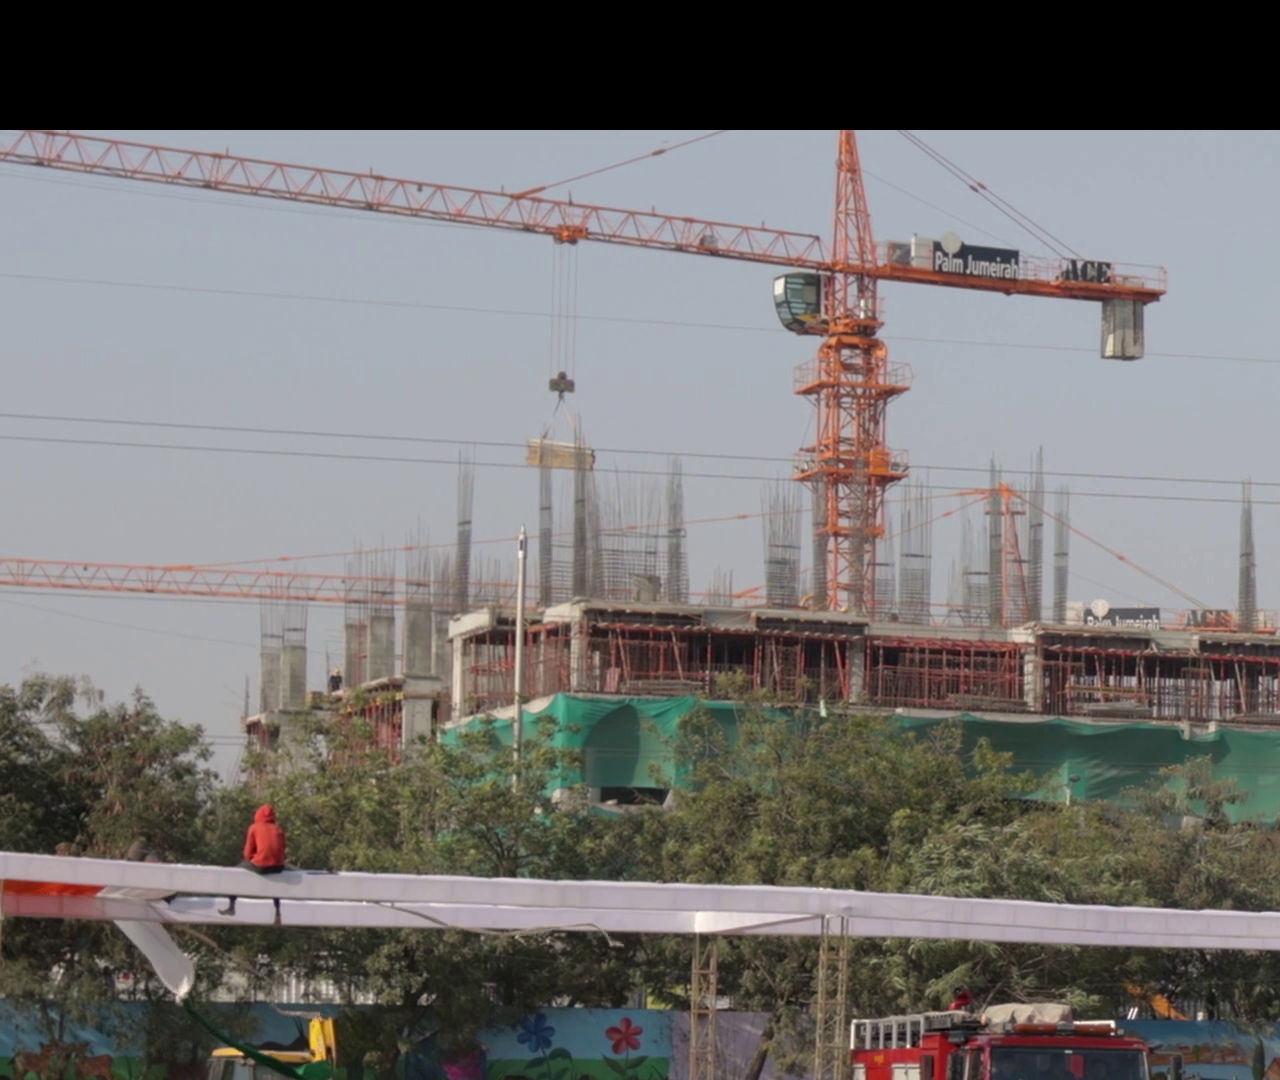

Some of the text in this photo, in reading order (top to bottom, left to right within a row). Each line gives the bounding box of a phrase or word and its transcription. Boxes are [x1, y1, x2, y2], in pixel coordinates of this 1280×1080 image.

[935, 250, 1019, 279] Palm Jumeirah
[1063, 259, 1111, 284] ACE
